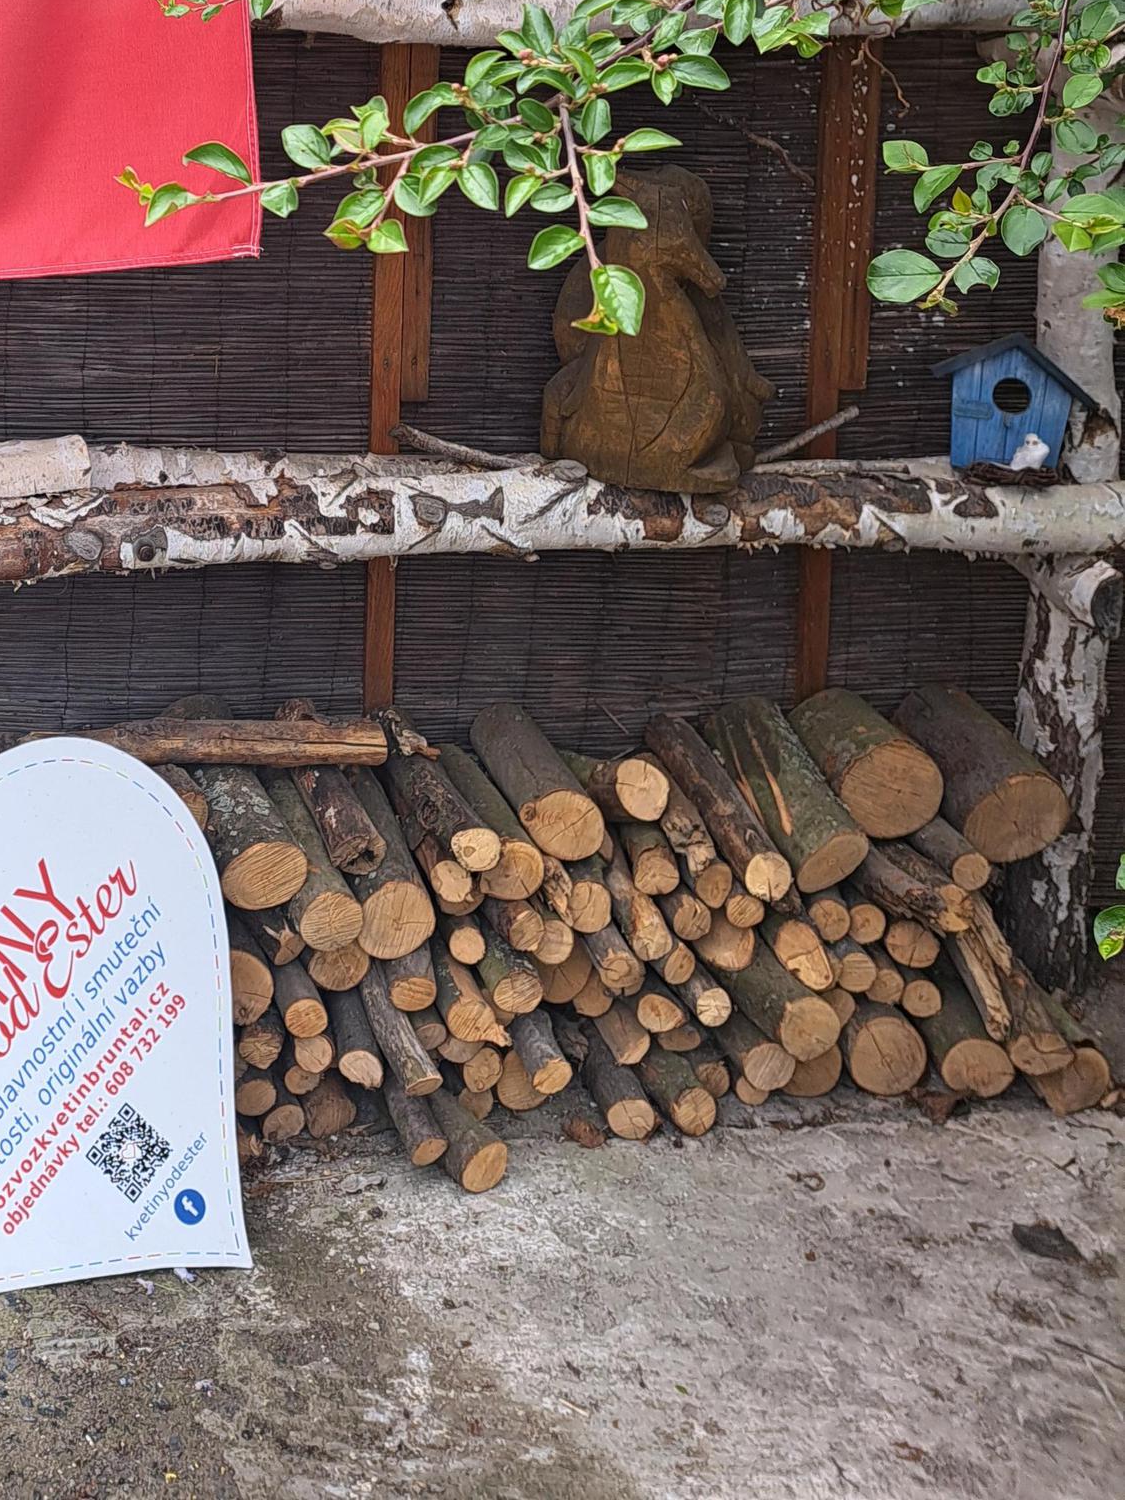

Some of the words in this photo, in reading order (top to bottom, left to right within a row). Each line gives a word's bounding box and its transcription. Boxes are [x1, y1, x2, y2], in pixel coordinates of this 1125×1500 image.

[34, 859, 137, 999] Ester
[70, 992, 86, 1012] i
[83, 895, 162, 1000] smuteční
[37, 997, 116, 1106] originální
[113, 940, 167, 1006] vazby
[2, 1132, 81, 1236] objednávky
[75, 1095, 109, 1134] tel.:
[104, 1060, 135, 1097] 608
[129, 1026, 162, 1063] 732
[156, 993, 187, 1030] 199
[123, 1131, 209, 1242] kvetinyodester
